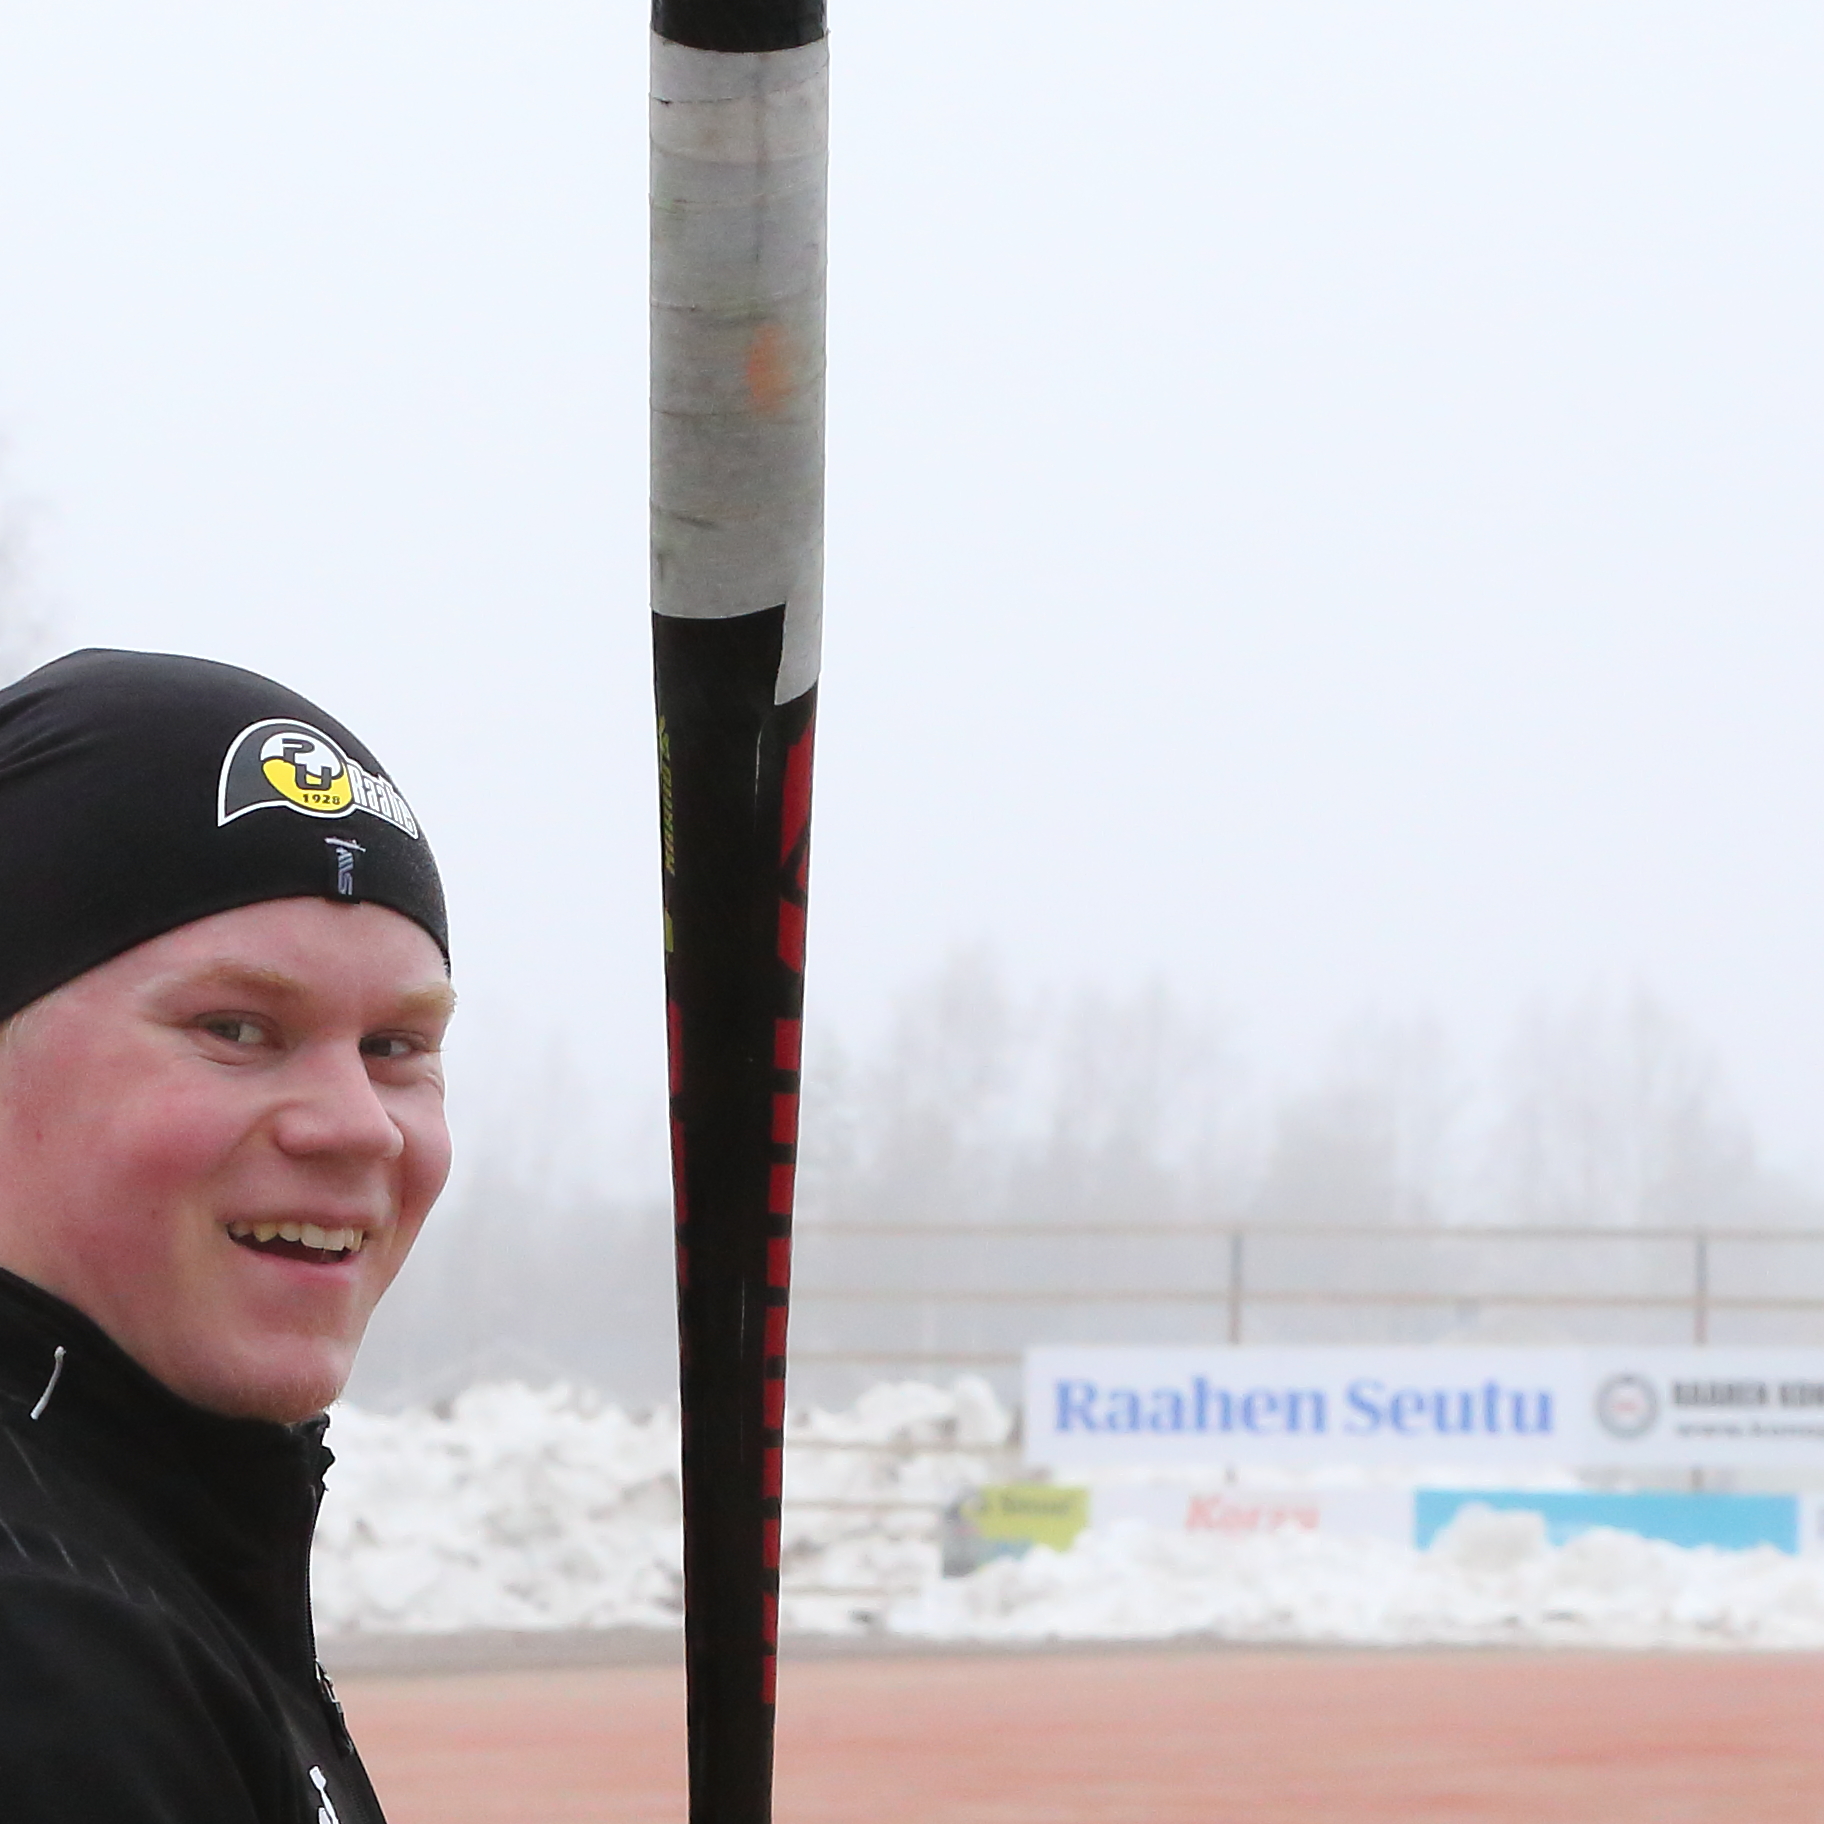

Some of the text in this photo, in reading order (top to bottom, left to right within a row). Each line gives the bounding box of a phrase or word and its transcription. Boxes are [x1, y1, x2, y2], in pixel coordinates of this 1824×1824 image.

[302, 793, 341, 806] 1928
[1053, 1375, 1556, 1437] Raahen Seutu
